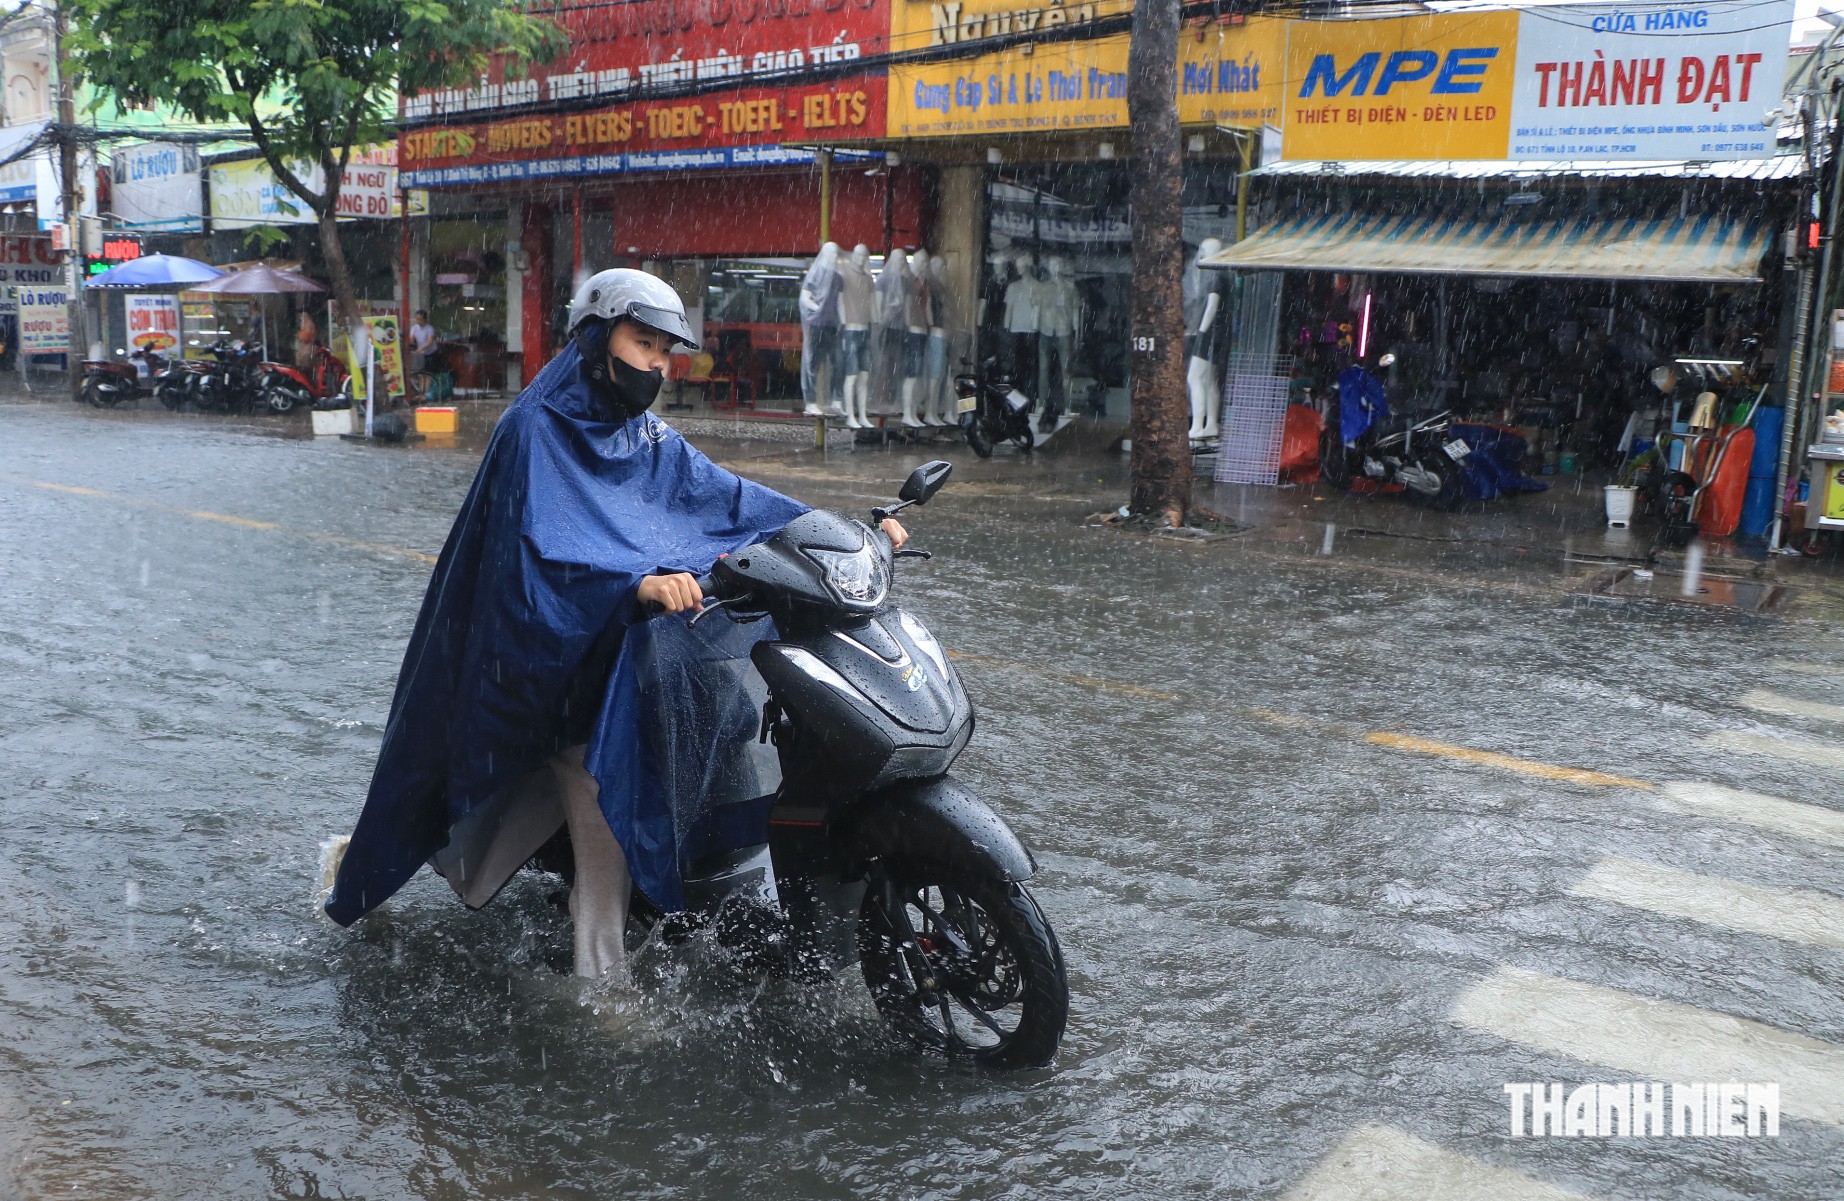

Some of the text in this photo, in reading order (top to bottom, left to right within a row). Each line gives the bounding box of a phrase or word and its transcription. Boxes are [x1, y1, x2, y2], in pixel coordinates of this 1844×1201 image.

[1591, 9, 1709, 33] CỬA HÀNG
[546, 59, 596, 101] THIẾU
[810, 29, 860, 68] TIẾP
[1182, 53, 1213, 97] Mới
[1218, 50, 1260, 95] Nhất
[1298, 46, 1500, 98] MPE
[914, 79, 950, 114] Cung
[955, 68, 982, 113] Cấp
[1008, 72, 1019, 104] &
[1088, 67, 1127, 100] Tran
[1535, 49, 1763, 112] THÀNH ĐẠT
[487, 121, 552, 154] MOVERS
[566, 110, 631, 146] FLYERS
[647, 105, 704, 140] TOEIC
[719, 98, 782, 133] TOEFL
[803, 90, 867, 130] IELTS
[1296, 104, 1341, 124] THIẾT
[1345, 107, 1362, 126] BỊ
[1366, 104, 1406, 126] ĐIỆN
[1424, 104, 1458, 122] ĐÈN
[1464, 105, 1497, 121] LED
[131, 149, 177, 181] LÒ RƯỢU
[367, 191, 388, 215] ĐÔ
[104, 239, 140, 262] RƯỢU
[15, 270, 51, 282] KHO
[21, 290, 34, 306] LÒ
[38, 291, 67, 309] RƯỢU
[24, 320, 53, 334] RƯỢU
[130, 307, 151, 331] CƠM
[1132, 336, 1155, 352] 181
